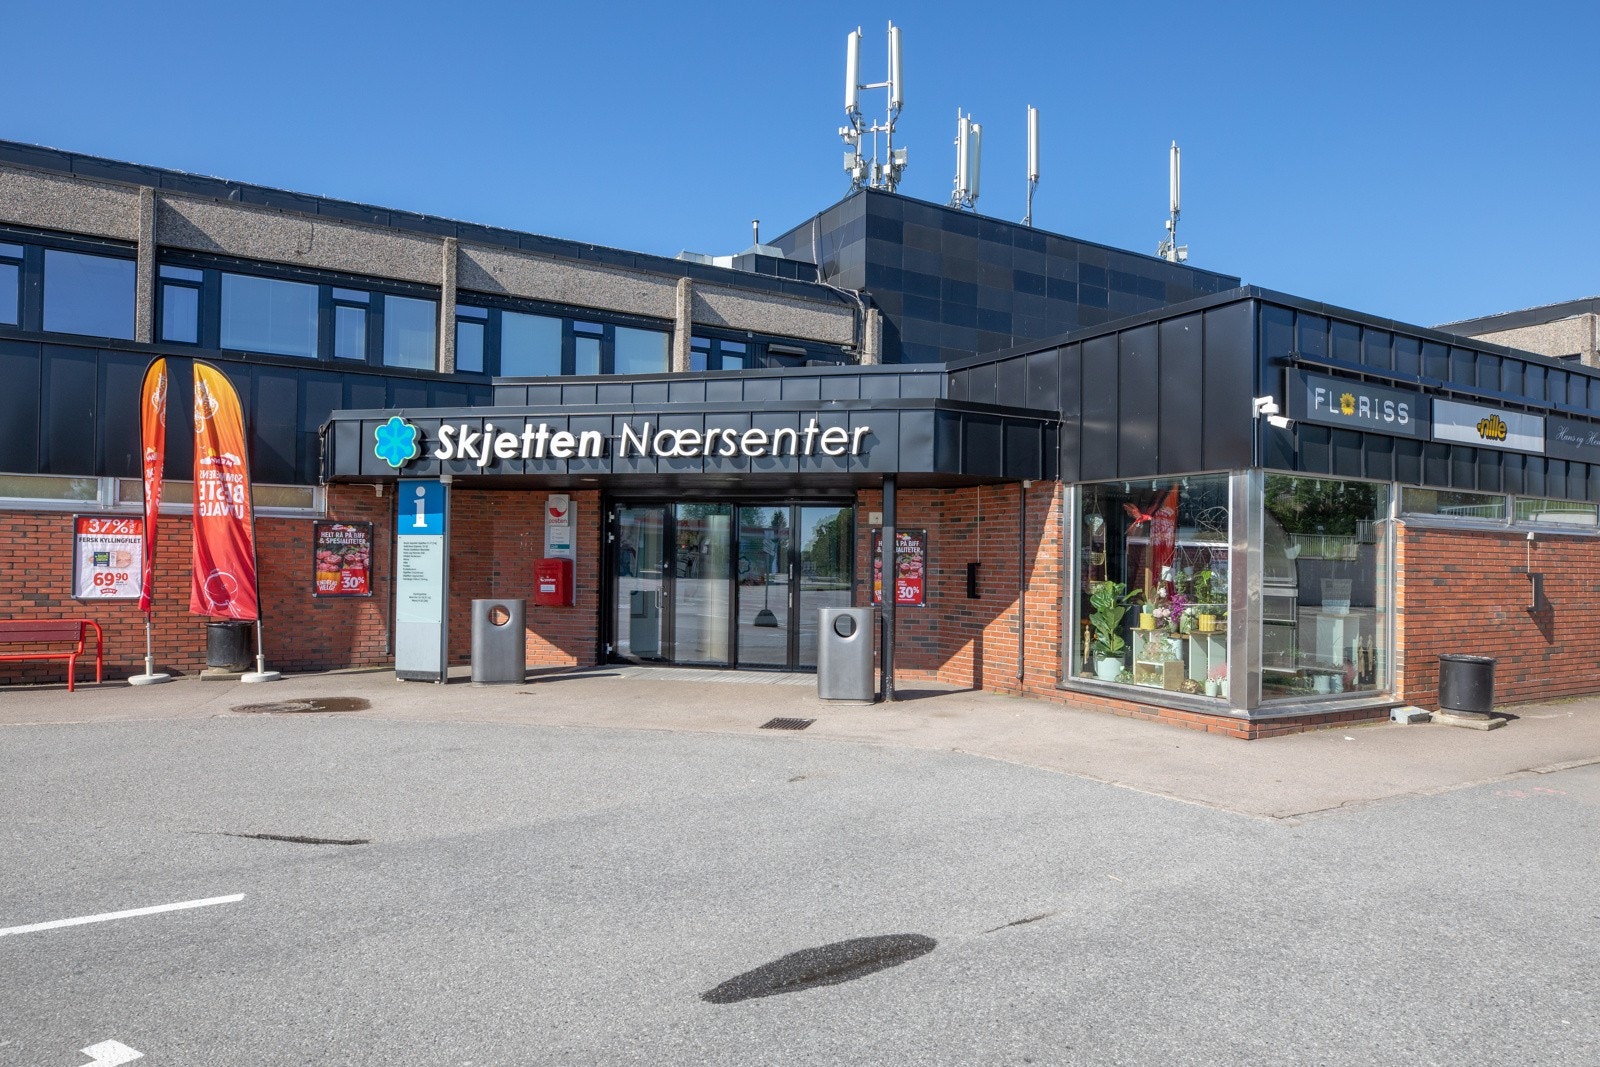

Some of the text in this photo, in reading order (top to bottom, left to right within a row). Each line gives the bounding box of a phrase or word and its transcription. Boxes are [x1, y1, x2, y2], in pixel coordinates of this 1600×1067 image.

[1315, 387, 1409, 424] FLORISS
[1480, 414, 1507, 441] nille
[1556, 425, 1576, 442] Hans
[434, 418, 870, 467] Skjetten Nærsenter
[88, 518, 129, 534] 37%
[93, 572, 114, 587] 69
